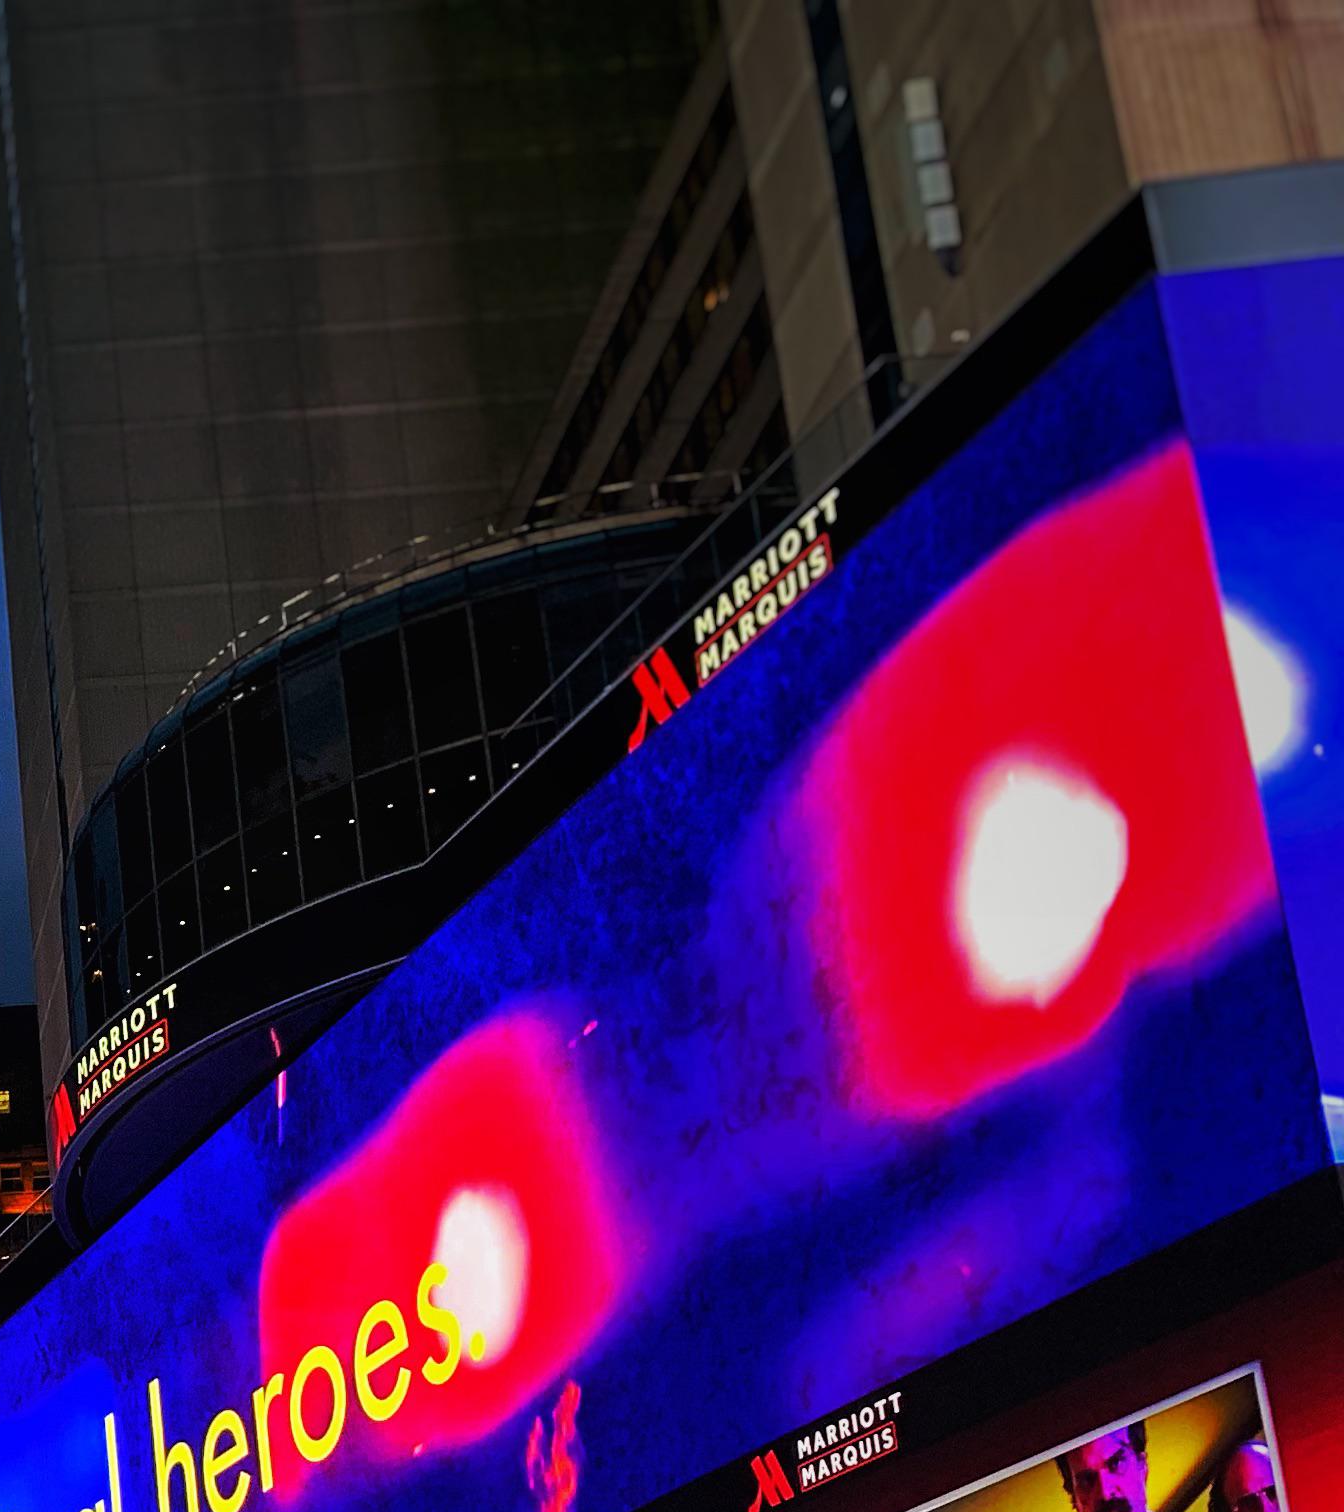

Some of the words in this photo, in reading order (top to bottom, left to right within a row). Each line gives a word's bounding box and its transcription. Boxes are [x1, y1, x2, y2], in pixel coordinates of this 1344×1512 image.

[694, 487, 840, 644] MARRIOTT
[699, 544, 828, 681] MARQUIS
[78, 983, 177, 1084] MARRIOTT
[79, 1027, 165, 1116] MARQUIS
[797, 1391, 902, 1458] MARRIOTT
[801, 1427, 895, 1487] MARQUIS
